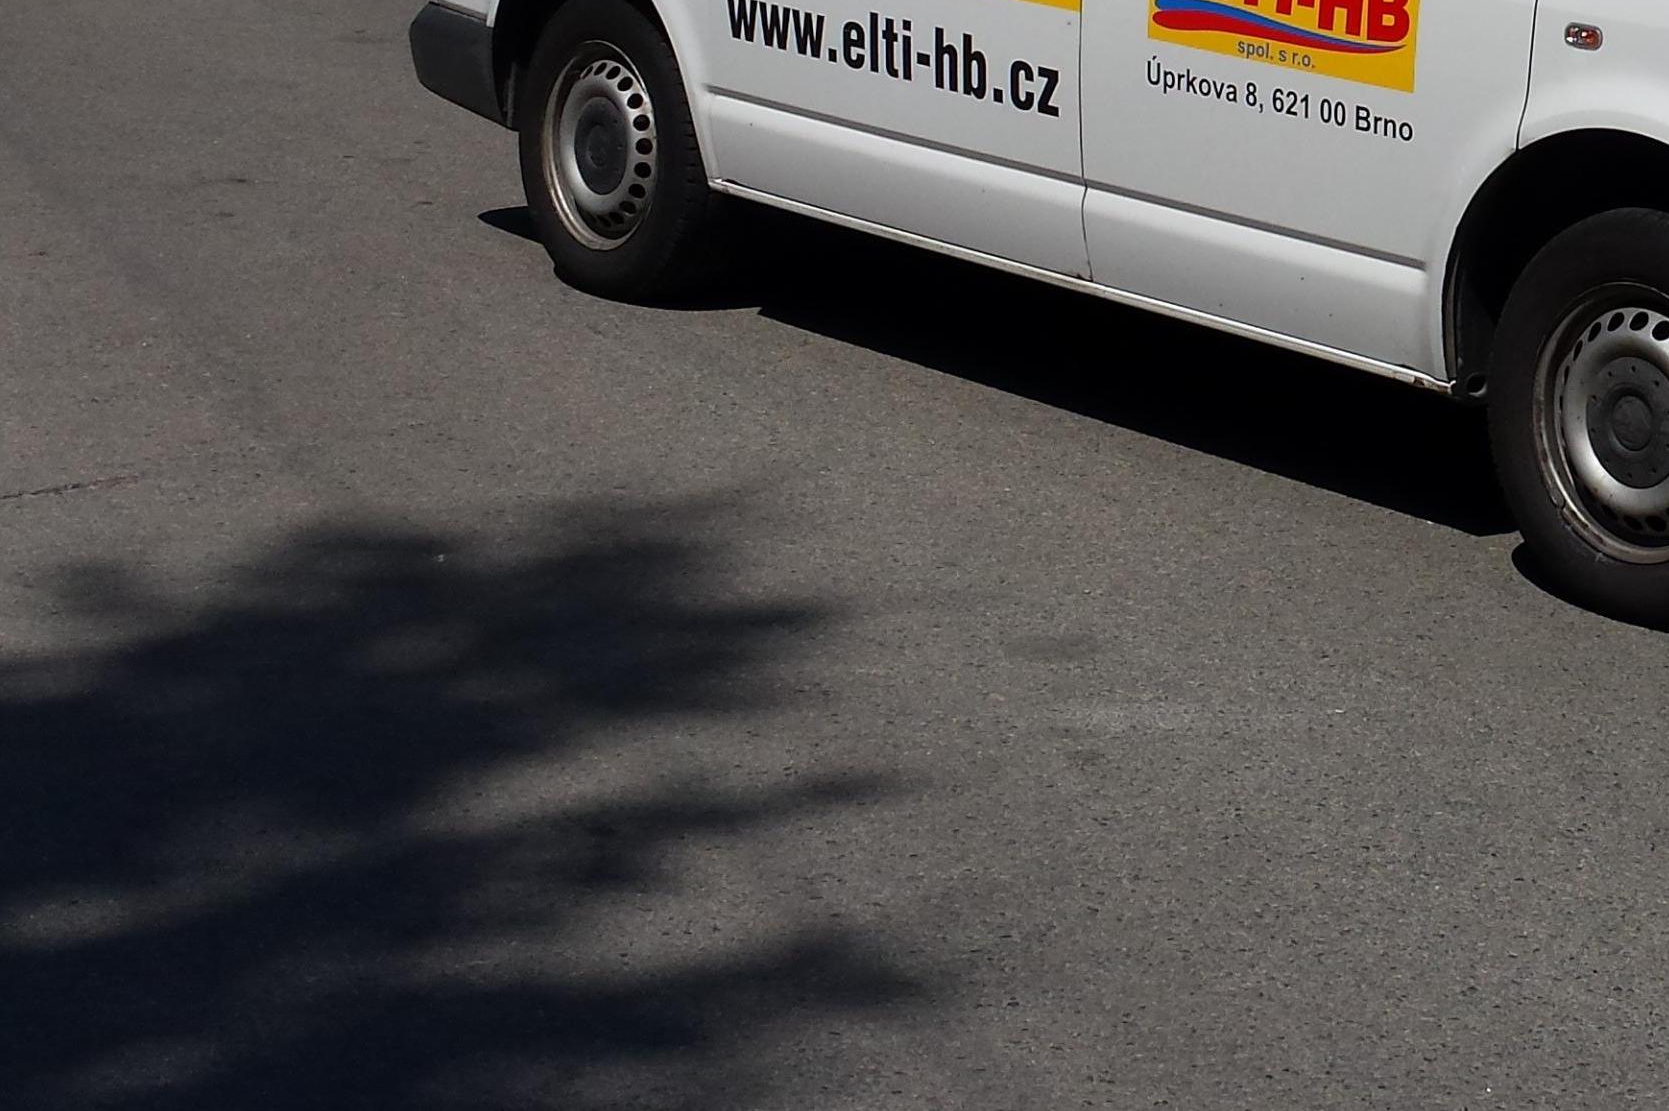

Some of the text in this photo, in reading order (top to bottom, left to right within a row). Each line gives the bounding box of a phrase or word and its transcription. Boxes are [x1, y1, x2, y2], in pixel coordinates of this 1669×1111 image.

[1237, 39, 1316, 69] spol. s r.o.
[1146, 55, 1414, 142] Úprkova 8, 621 00 Brno
